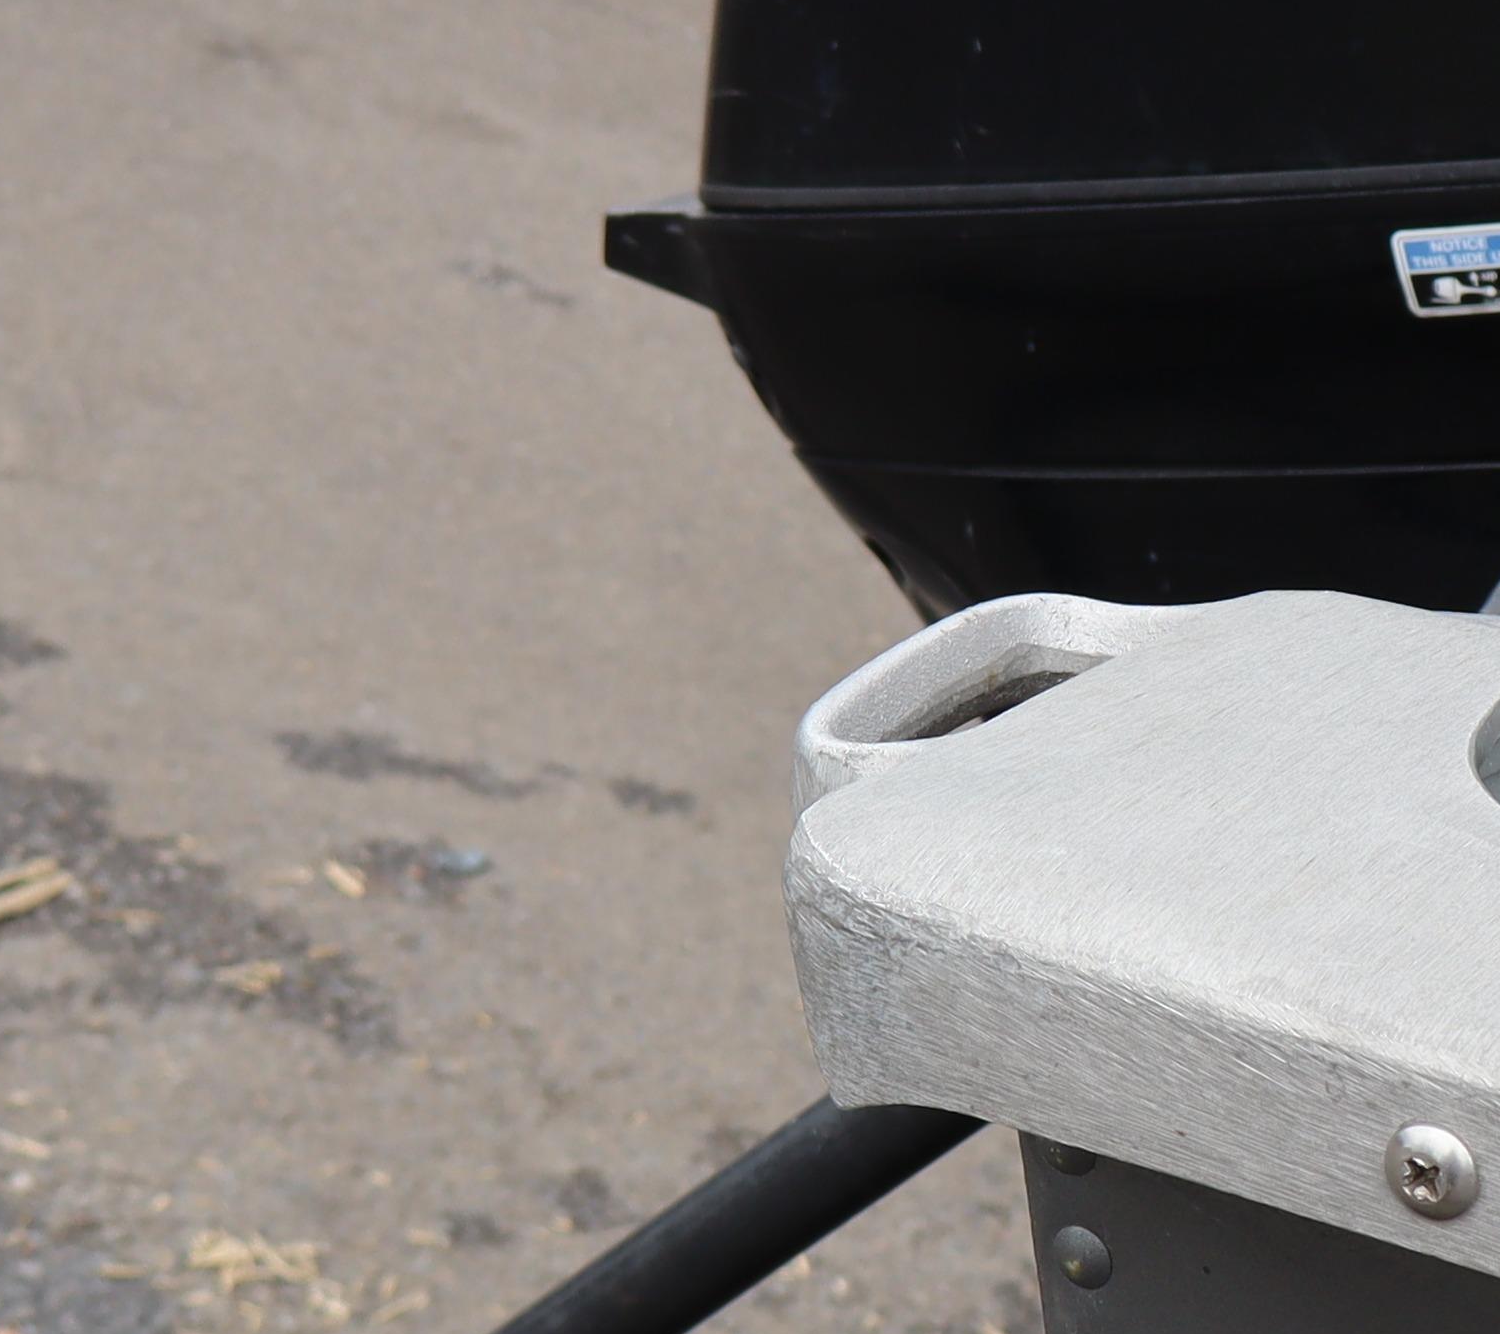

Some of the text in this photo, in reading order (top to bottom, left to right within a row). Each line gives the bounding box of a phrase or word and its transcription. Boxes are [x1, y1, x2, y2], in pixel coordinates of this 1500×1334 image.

[1431, 237, 1487, 253] NOTICE
[1411, 254, 1448, 269] THIS
[1452, 252, 1486, 266] SIDE
